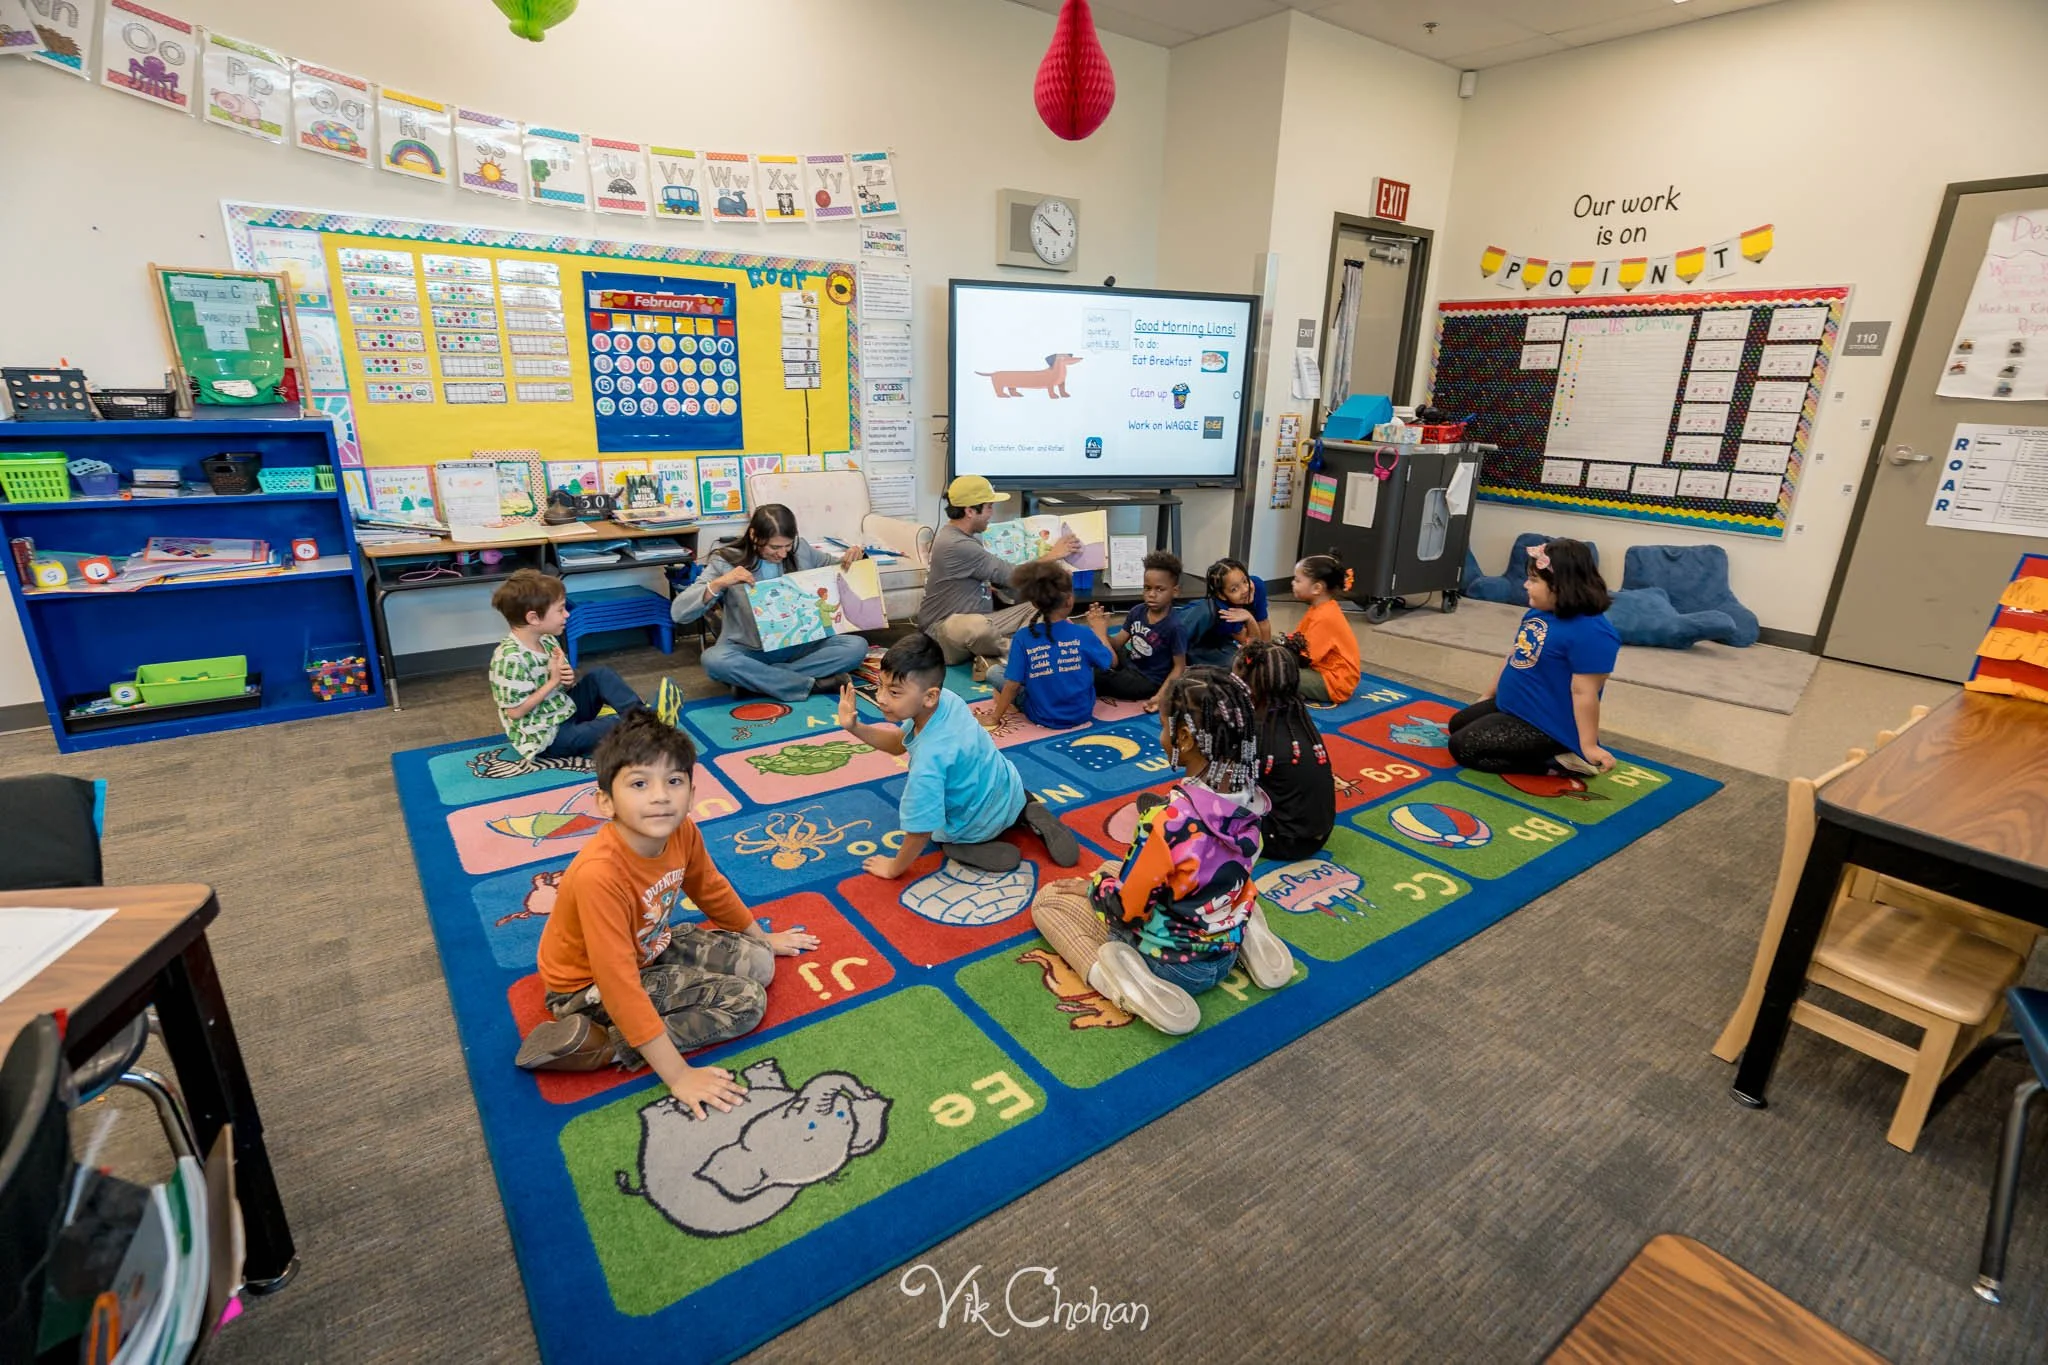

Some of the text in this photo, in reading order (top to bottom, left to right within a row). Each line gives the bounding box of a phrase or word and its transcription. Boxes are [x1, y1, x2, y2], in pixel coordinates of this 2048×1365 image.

[123, 22, 185, 65] Oo
[226, 55, 274, 98] Pp
[309, 86, 365, 130] Qq
[659, 161, 694, 186] Vv
[708, 166, 749, 188] Ww
[767, 168, 798, 191] Xx
[816, 168, 842, 193] Yy
[862, 165, 888, 187] Zz
[1380, 182, 1406, 217] EXIT
[1573, 185, 1681, 218] Our work
[1596, 226, 1647, 246] is on
[634, 296, 694, 312] February
[1134, 318, 1237, 339] Good Morning Lions!
[620, 339, 626, 347] 2
[686, 341, 692, 350] 5
[705, 341, 712, 351] 6
[723, 342, 729, 351] 7
[1133, 337, 1160, 349] To do:
[1856, 333, 1878, 344] 110
[1132, 354, 1192, 367] Eat Breakfast
[599, 380, 610, 390] 15
[874, 383, 903, 391] SUCCESS
[1130, 387, 1168, 402] Clean up
[623, 402, 634, 411] 23
[1128, 420, 1149, 430] Work
[1152, 422, 1163, 431] on
[658, 470, 689, 481] TURNS
[1360, 764, 1421, 783] Gg
[1606, 765, 1662, 788] Aa
[1507, 816, 1571, 843] Bb
[1392, 871, 1459, 901] Cc
[797, 956, 869, 1001] Jj
[928, 1071, 1036, 1127] Ee
